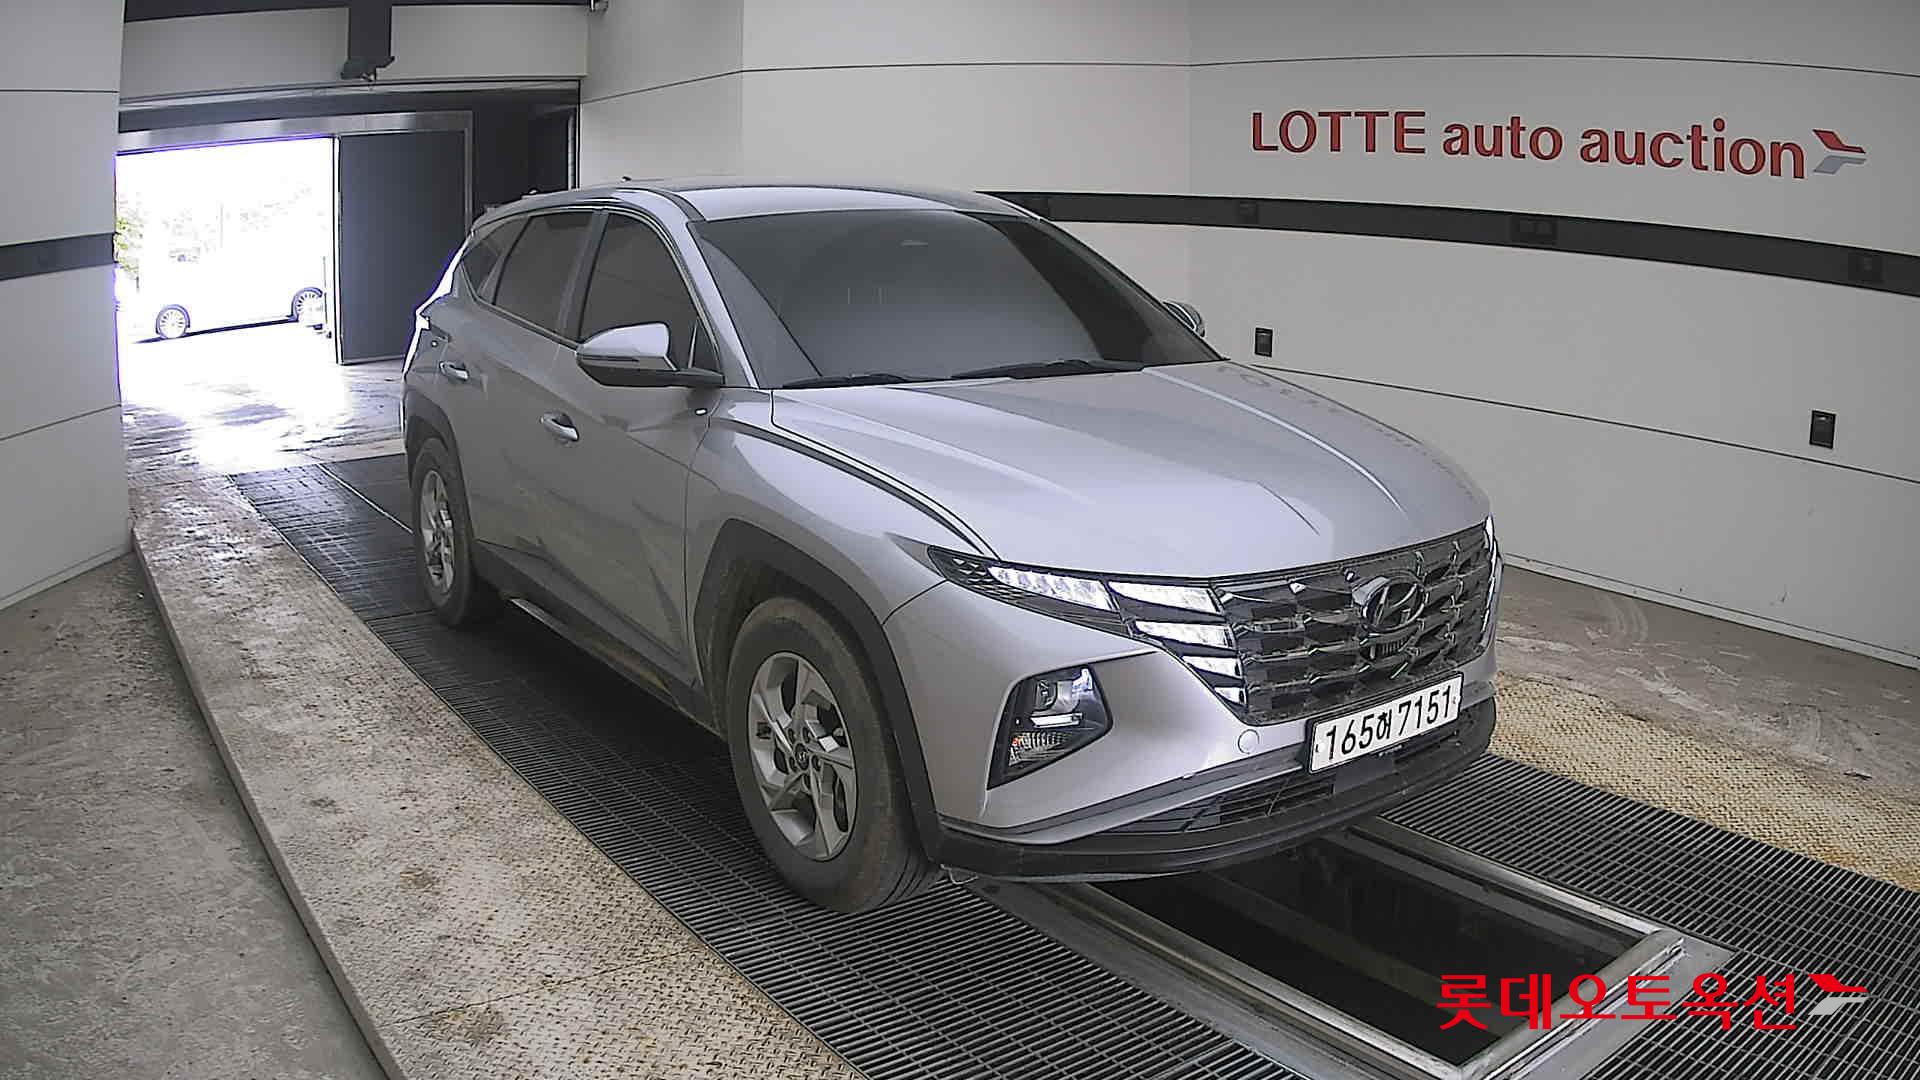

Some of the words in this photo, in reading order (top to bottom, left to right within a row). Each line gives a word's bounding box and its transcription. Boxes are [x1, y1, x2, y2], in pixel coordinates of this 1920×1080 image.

[1252, 110, 1426, 154] LOTTE
[1442, 116, 1563, 160] auto
[1579, 117, 1805, 180] auction
[1397, 684, 1452, 737] 7151
